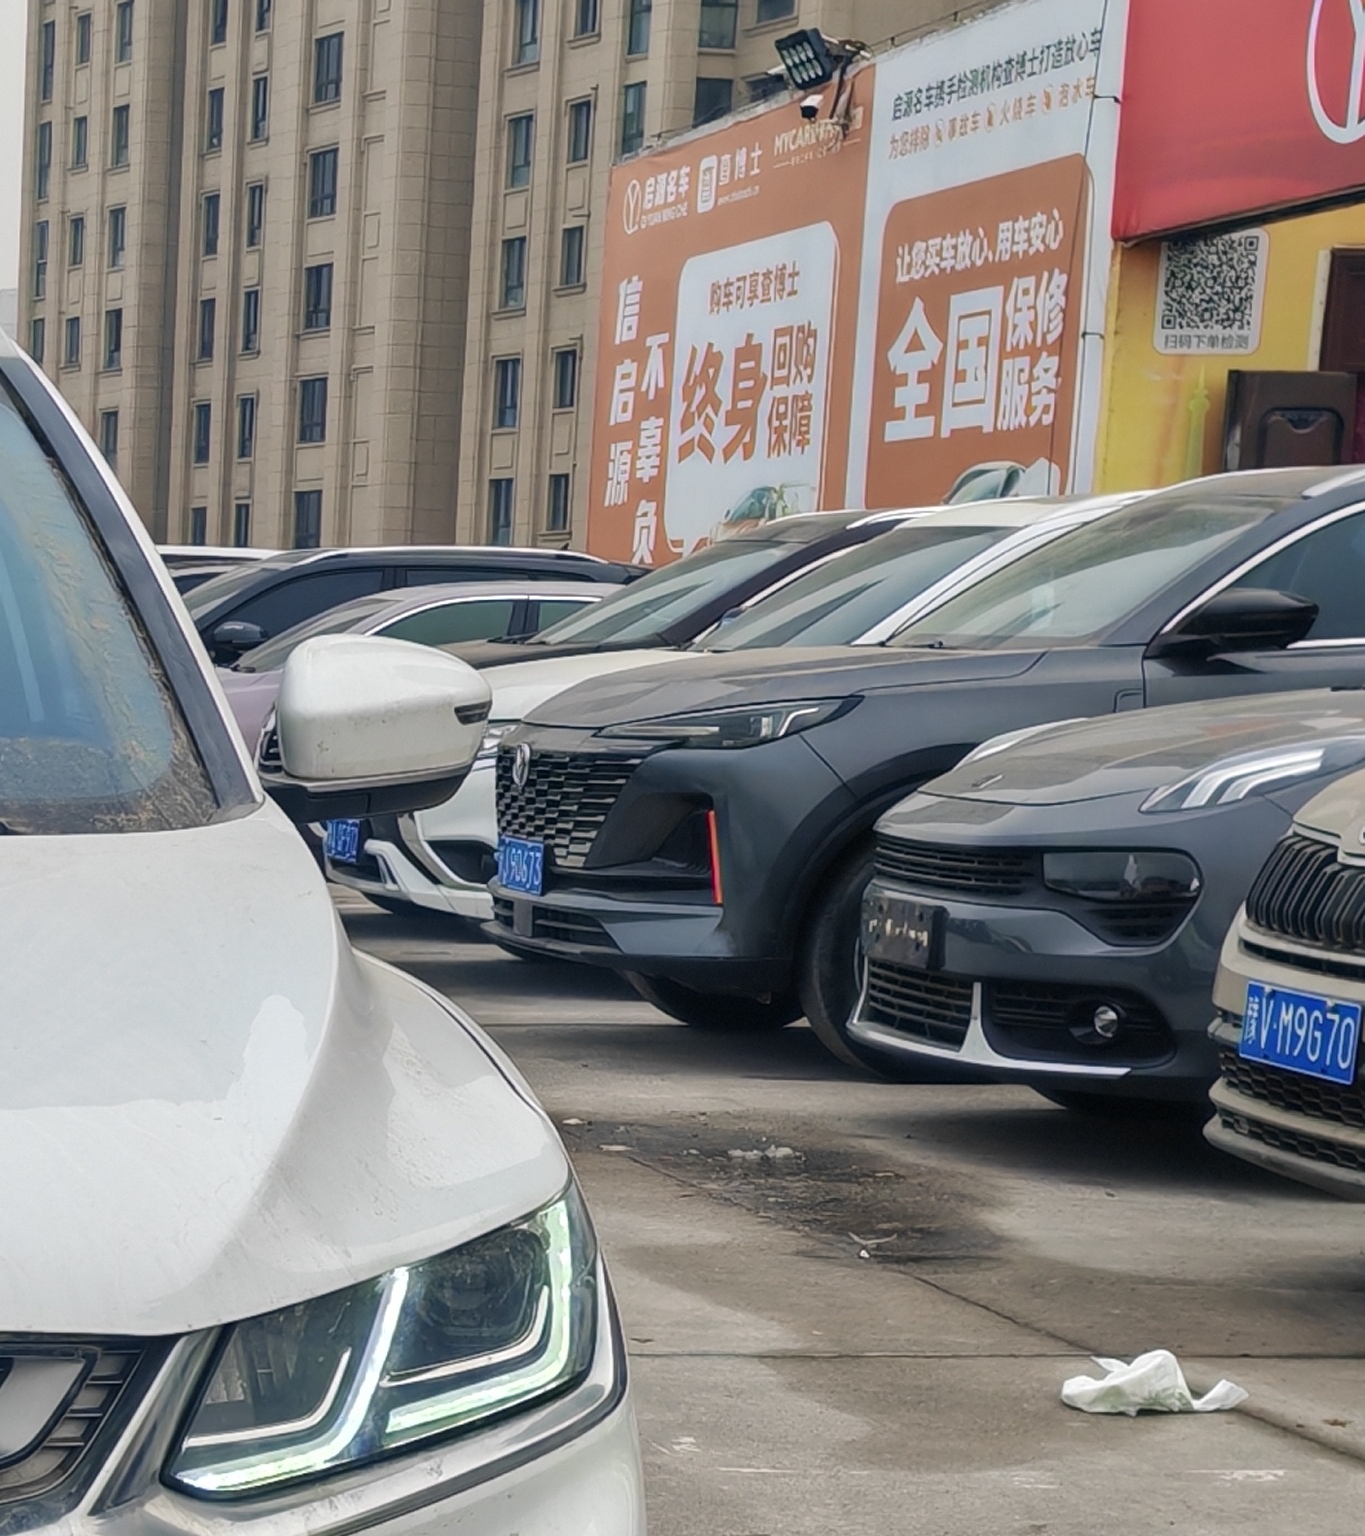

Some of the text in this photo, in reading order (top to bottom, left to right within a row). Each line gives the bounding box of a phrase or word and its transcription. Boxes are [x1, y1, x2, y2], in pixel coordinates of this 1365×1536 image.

[709, 261, 801, 315] 购车可享查博士
[1005, 267, 1068, 352] 保修
[770, 320, 817, 391] 回购
[884, 296, 1005, 443] 全国
[1164, 334, 1250, 350] 扫码下单检测
[603, 275, 643, 507] 信启源
[678, 332, 768, 465] 终身
[767, 391, 813, 459] 保障
[997, 350, 1061, 431] 服务
[631, 332, 669, 565] 不辜负
